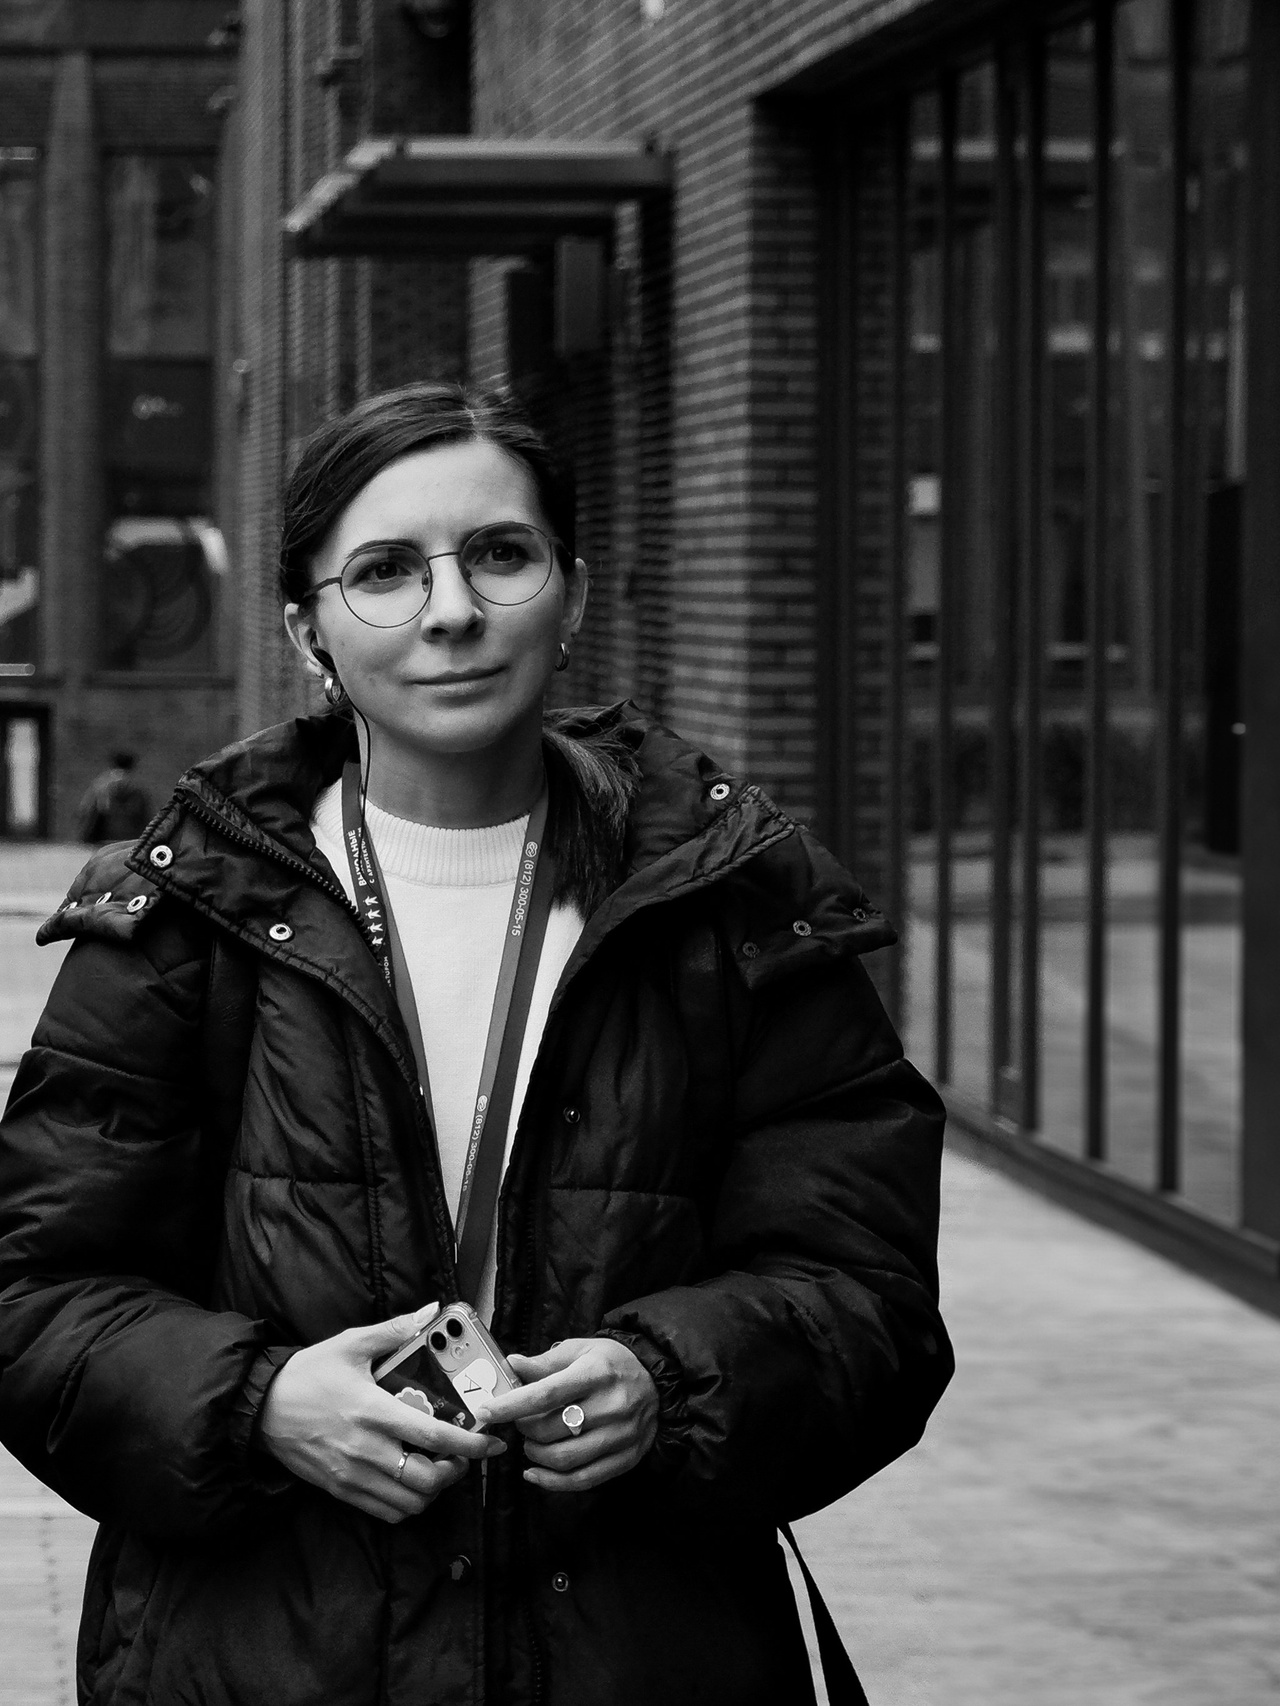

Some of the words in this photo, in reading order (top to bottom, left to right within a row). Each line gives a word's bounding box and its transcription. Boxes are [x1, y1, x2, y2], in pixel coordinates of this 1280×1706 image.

[523, 860, 535, 887] (812)
[511, 887, 529, 937] 300-05-15
[471, 1114, 483, 1140] (812)
